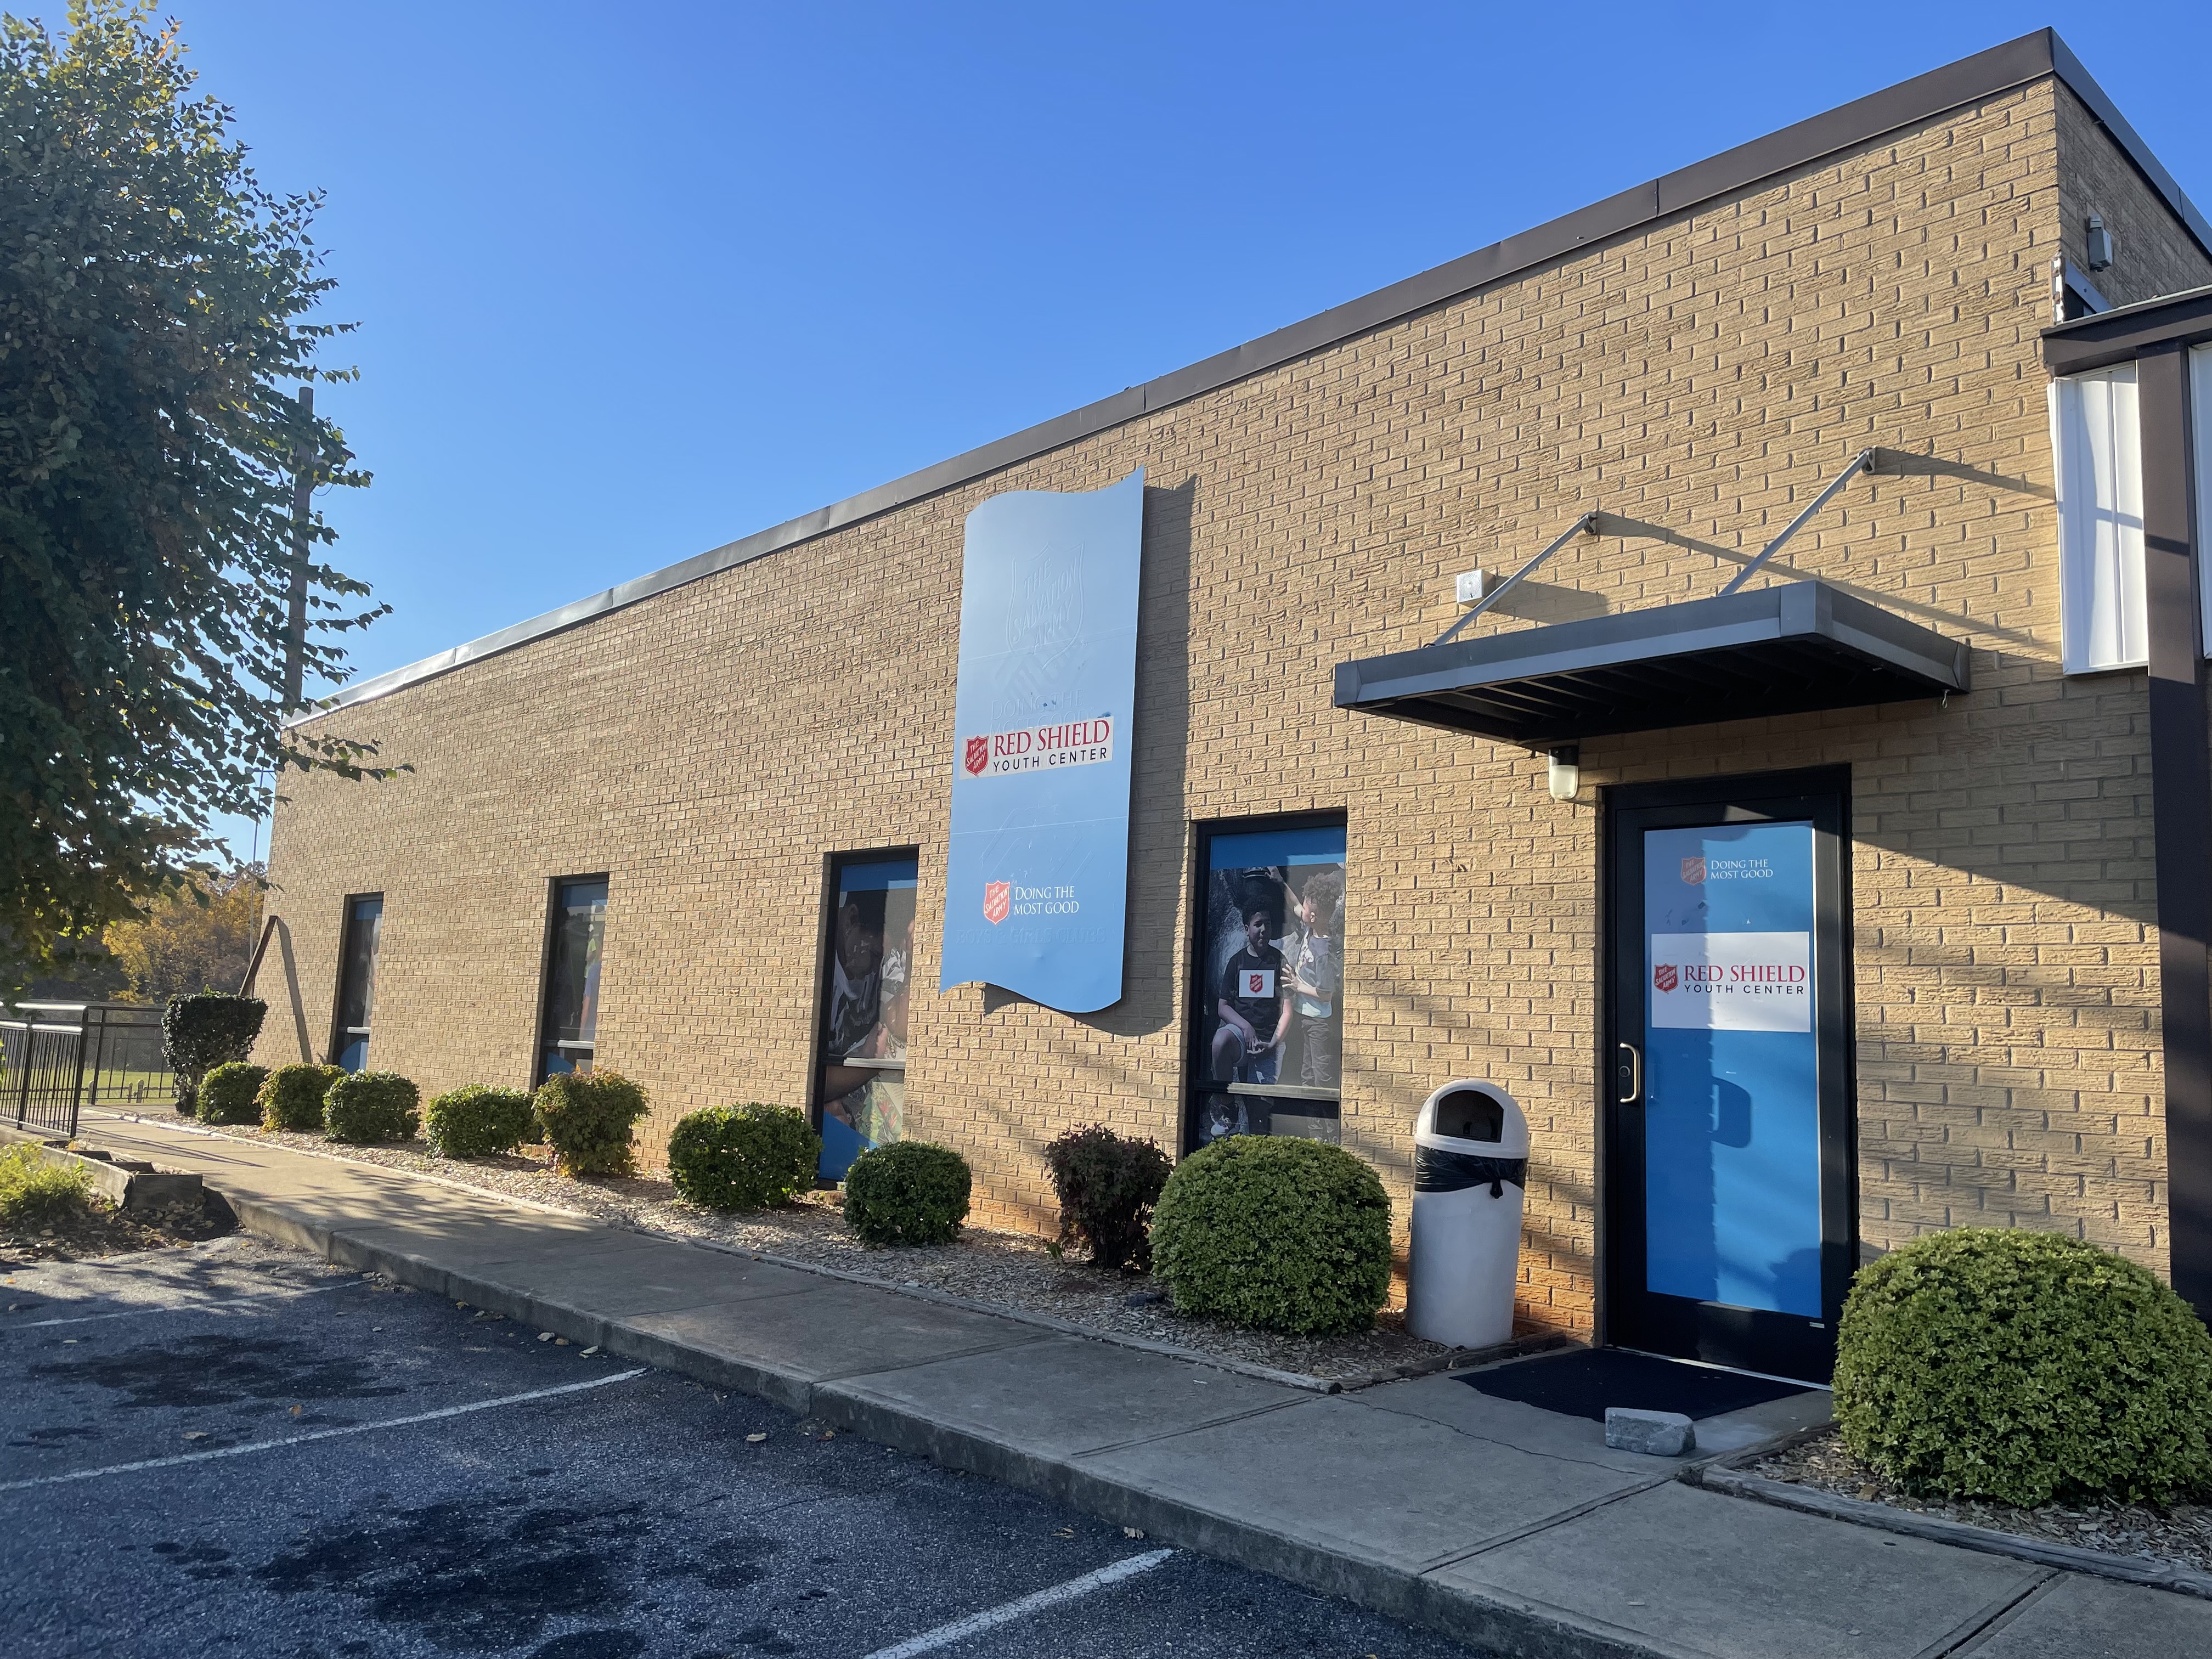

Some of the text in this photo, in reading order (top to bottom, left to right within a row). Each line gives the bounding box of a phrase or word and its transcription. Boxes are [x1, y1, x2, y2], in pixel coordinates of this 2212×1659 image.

[994, 720, 1110, 757] RED SHIELD
[966, 740, 987, 767] SALVATION
[970, 740, 979, 753] THE
[973, 751, 986, 771] ARMY
[994, 747, 1107, 772] YOUTH CENTER
[1711, 859, 1768, 870] DOING THE
[1711, 868, 1774, 879] MOST GOOD
[989, 884, 1000, 899] THE
[1015, 885, 1075, 900] DOING THE
[985, 885, 1008, 914] SALVATION
[992, 898, 1007, 919] ARMY
[1013, 901, 1080, 916] MOST GOOD
[1658, 966, 1667, 976] THE
[1684, 964, 1805, 983] RED SHIELD
[1684, 985, 1804, 994] YOUTH CENTER
